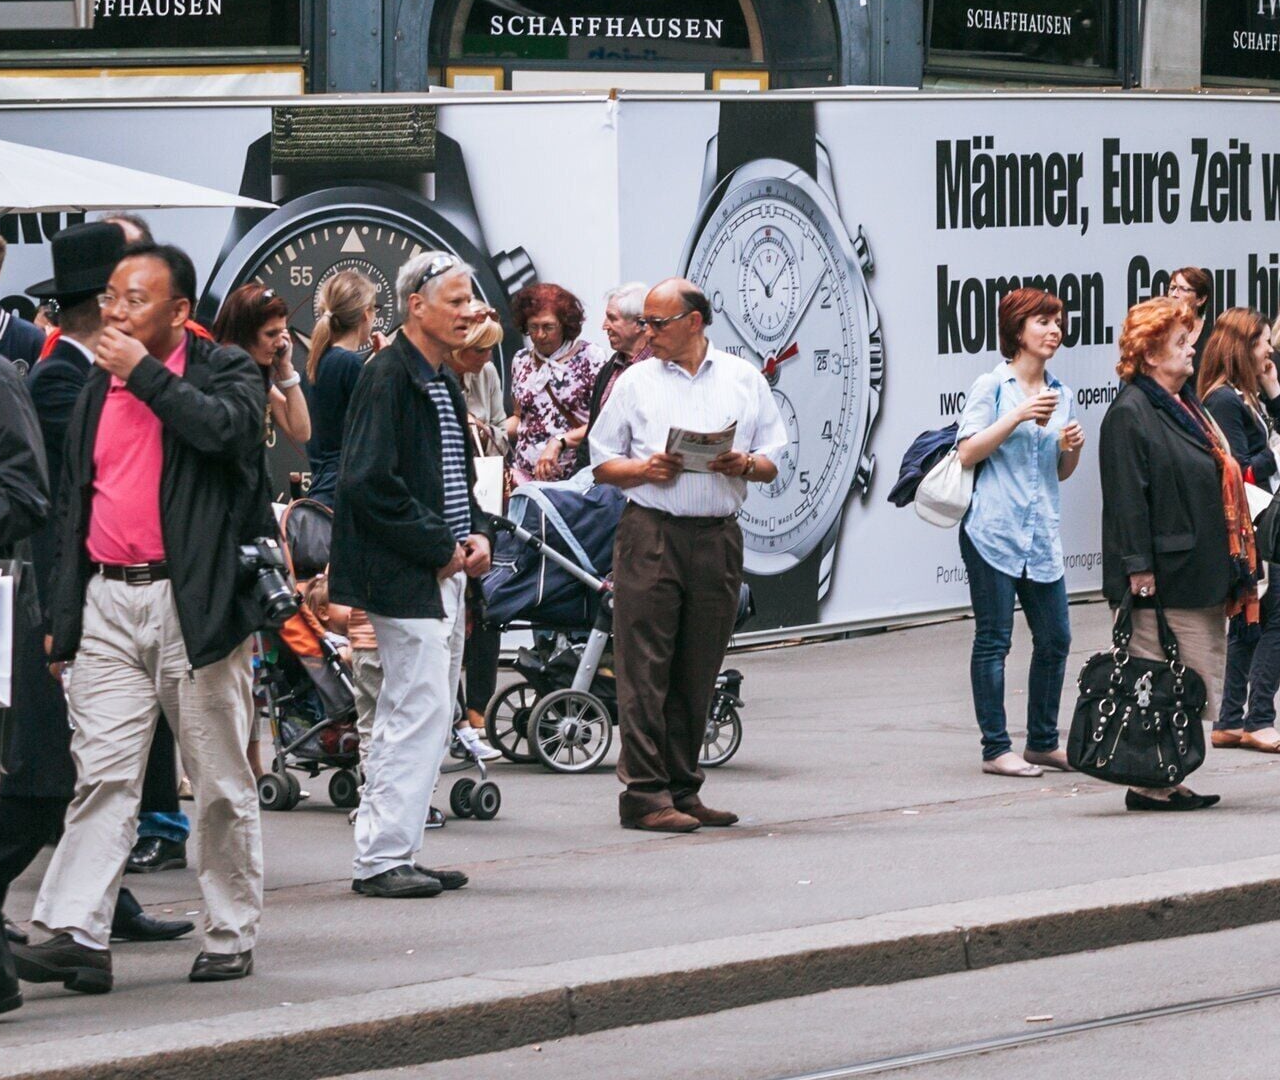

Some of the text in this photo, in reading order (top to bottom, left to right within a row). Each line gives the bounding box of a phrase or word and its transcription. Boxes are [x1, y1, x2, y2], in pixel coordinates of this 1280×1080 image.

[490, 14, 724, 39] SCHAFFHAUSEN
[966, 8, 1072, 35] SCHAFFHAUSEN
[936, 136, 1089, 237] Männer,
[1102, 137, 1180, 225] Eure
[1190, 137, 1252, 224] Zeit
[290, 265, 313, 287] 55
[936, 264, 1114, 355] koen.
[817, 355, 828, 371] 25
[1077, 381, 1119, 410] openin
[799, 471, 812, 495] 5
[936, 565, 970, 585] Portug
